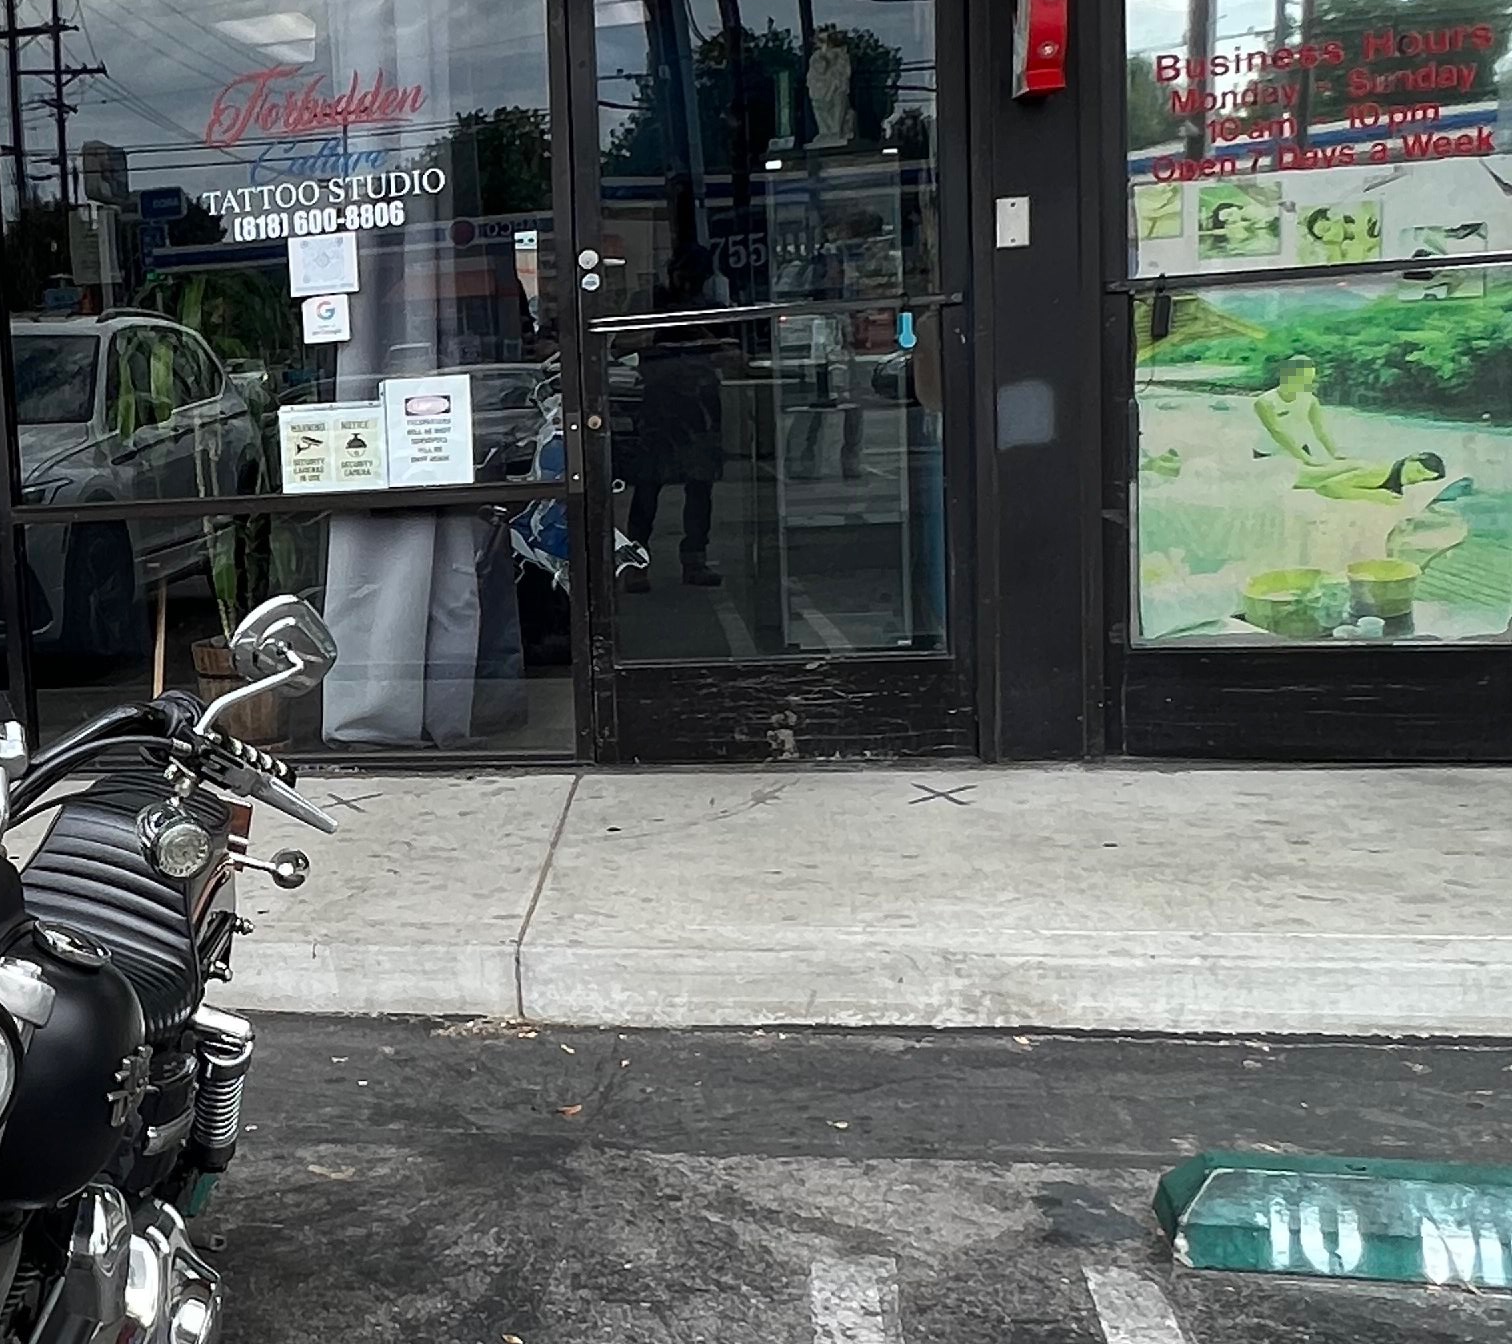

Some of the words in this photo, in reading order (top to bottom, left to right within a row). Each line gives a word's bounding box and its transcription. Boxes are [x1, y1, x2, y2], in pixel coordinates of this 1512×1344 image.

[1155, 41, 1344, 83] Business
[1363, 23, 1494, 62] Hours
[205, 61, 428, 148] Forbidden
[1169, 76, 1301, 116] Monday
[1347, 62, 1478, 98] Sunday
[1348, 104, 1379, 128] 10
[1152, 152, 1237, 182] Open
[1277, 139, 1355, 171] Days
[1370, 142, 1387, 164] a
[1401, 126, 1496, 156] Week
[202, 182, 319, 216] TATTOO
[328, 168, 446, 204] STUDIO
[234, 212, 288, 242] (818)
[294, 201, 406, 237] 600-8806
